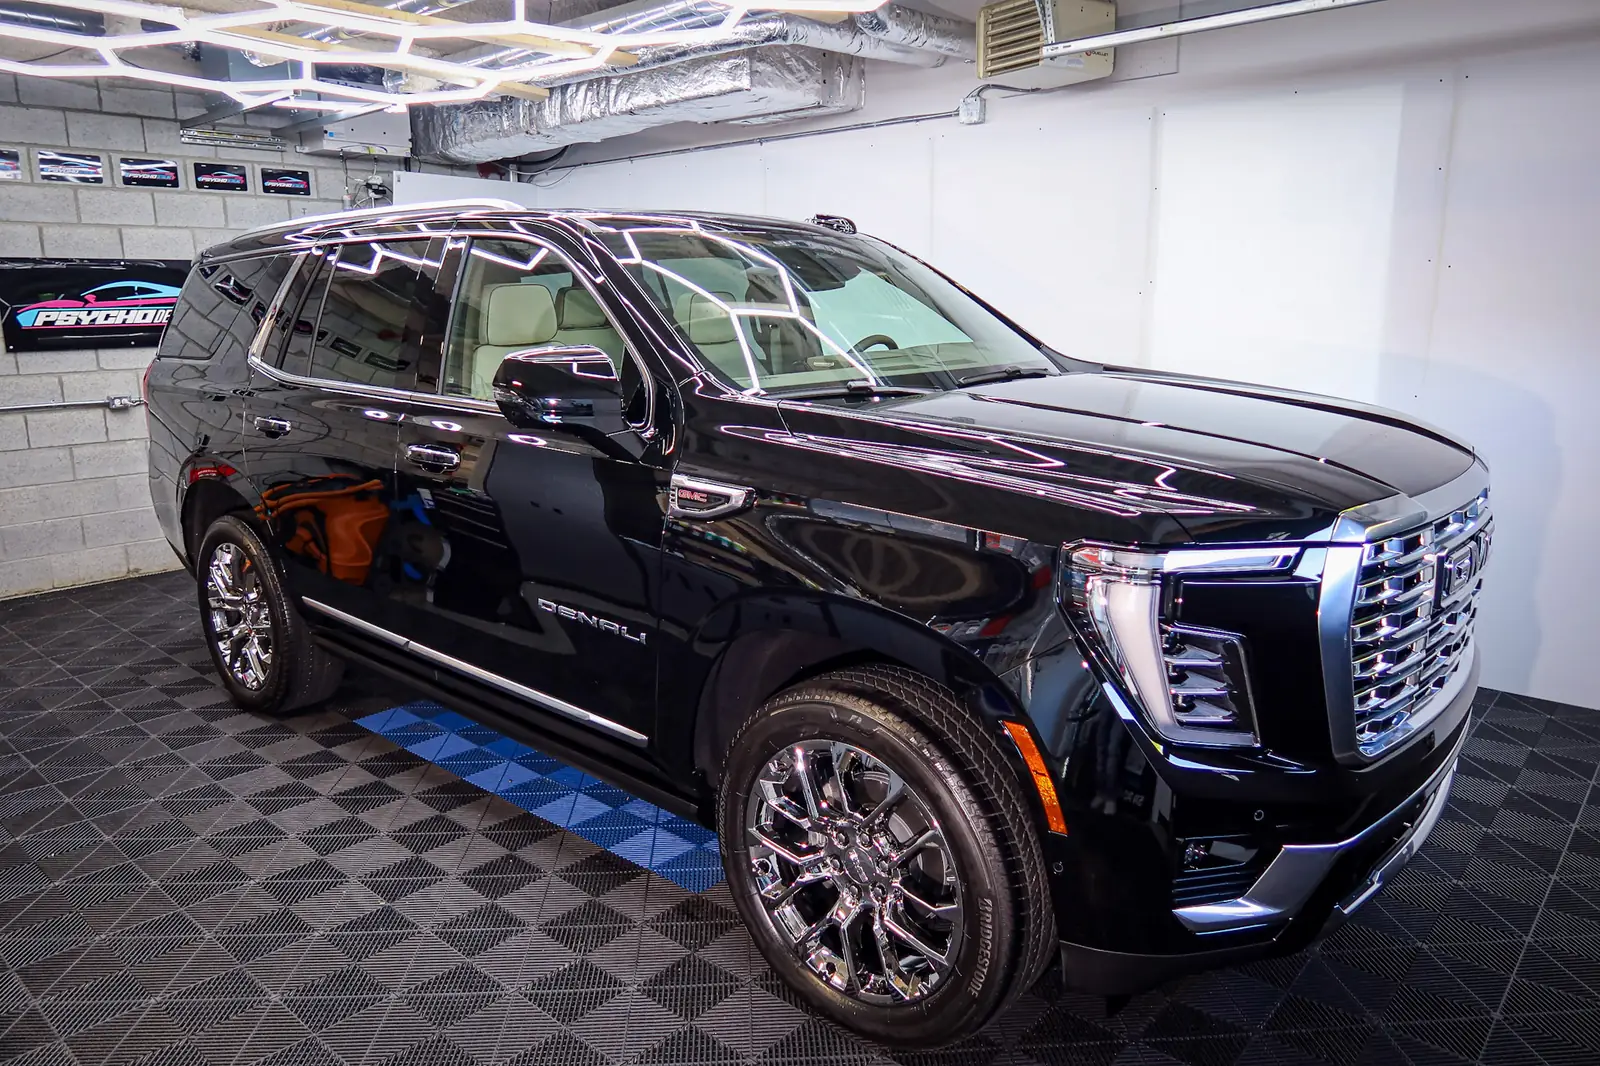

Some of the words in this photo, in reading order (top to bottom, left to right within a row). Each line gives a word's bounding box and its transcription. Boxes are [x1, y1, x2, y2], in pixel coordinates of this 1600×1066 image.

[678, 488, 707, 503] GMC
[537, 597, 647, 645] DENALI
[967, 897, 993, 998] BRIDGESTONE
